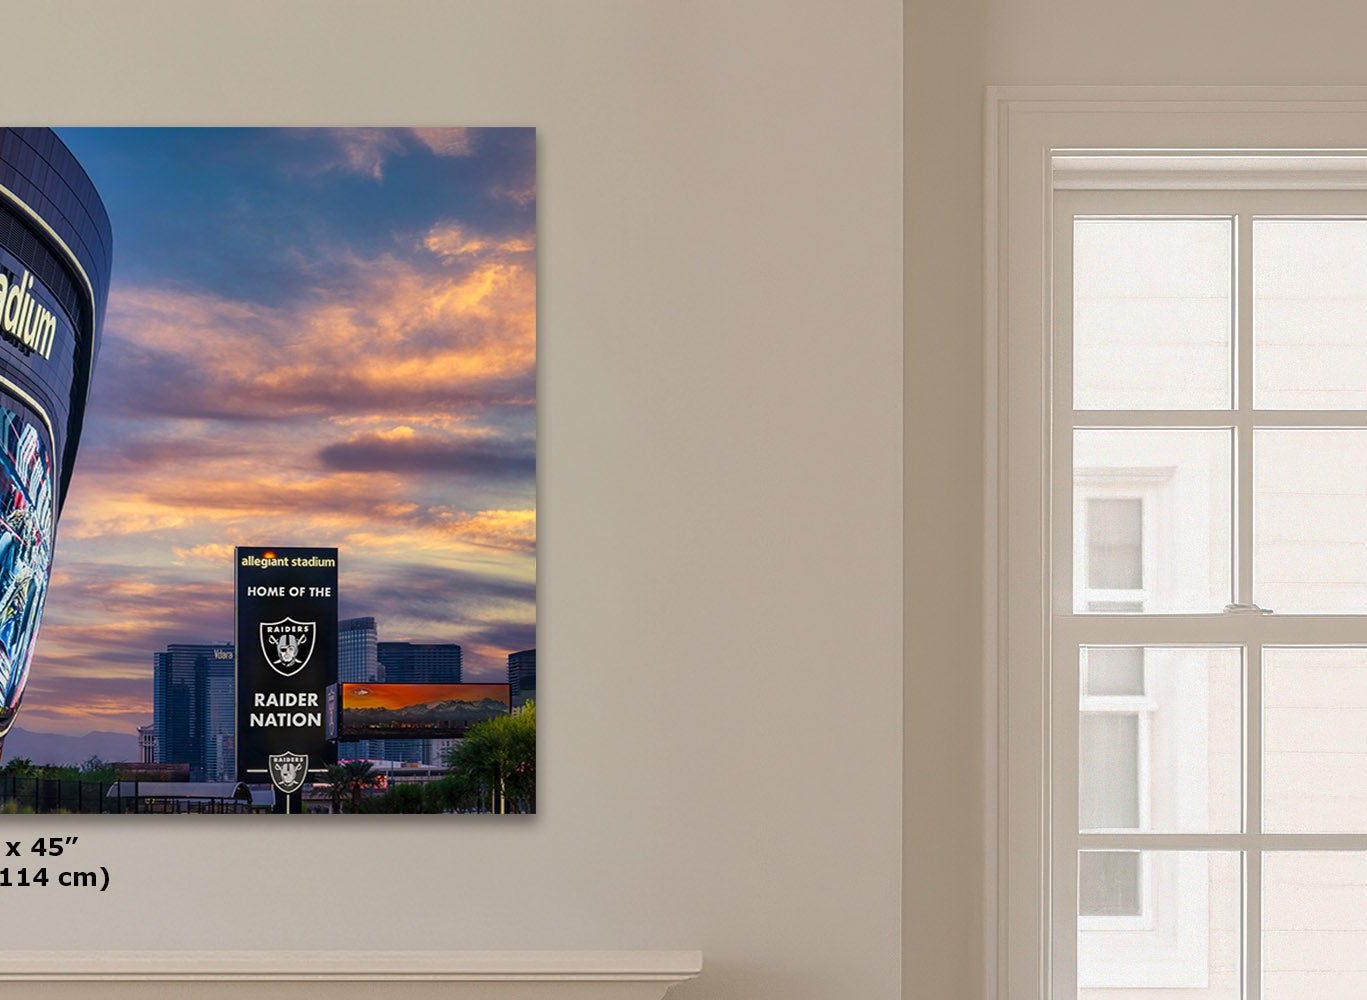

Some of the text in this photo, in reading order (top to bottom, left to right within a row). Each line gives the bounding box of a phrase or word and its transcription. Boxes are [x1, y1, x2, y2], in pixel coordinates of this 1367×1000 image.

[241, 555, 336, 569] allegiant stadium
[247, 586, 331, 597] HOME OF THE
[254, 693, 318, 707] RAIDER
[250, 713, 322, 727] NATION
